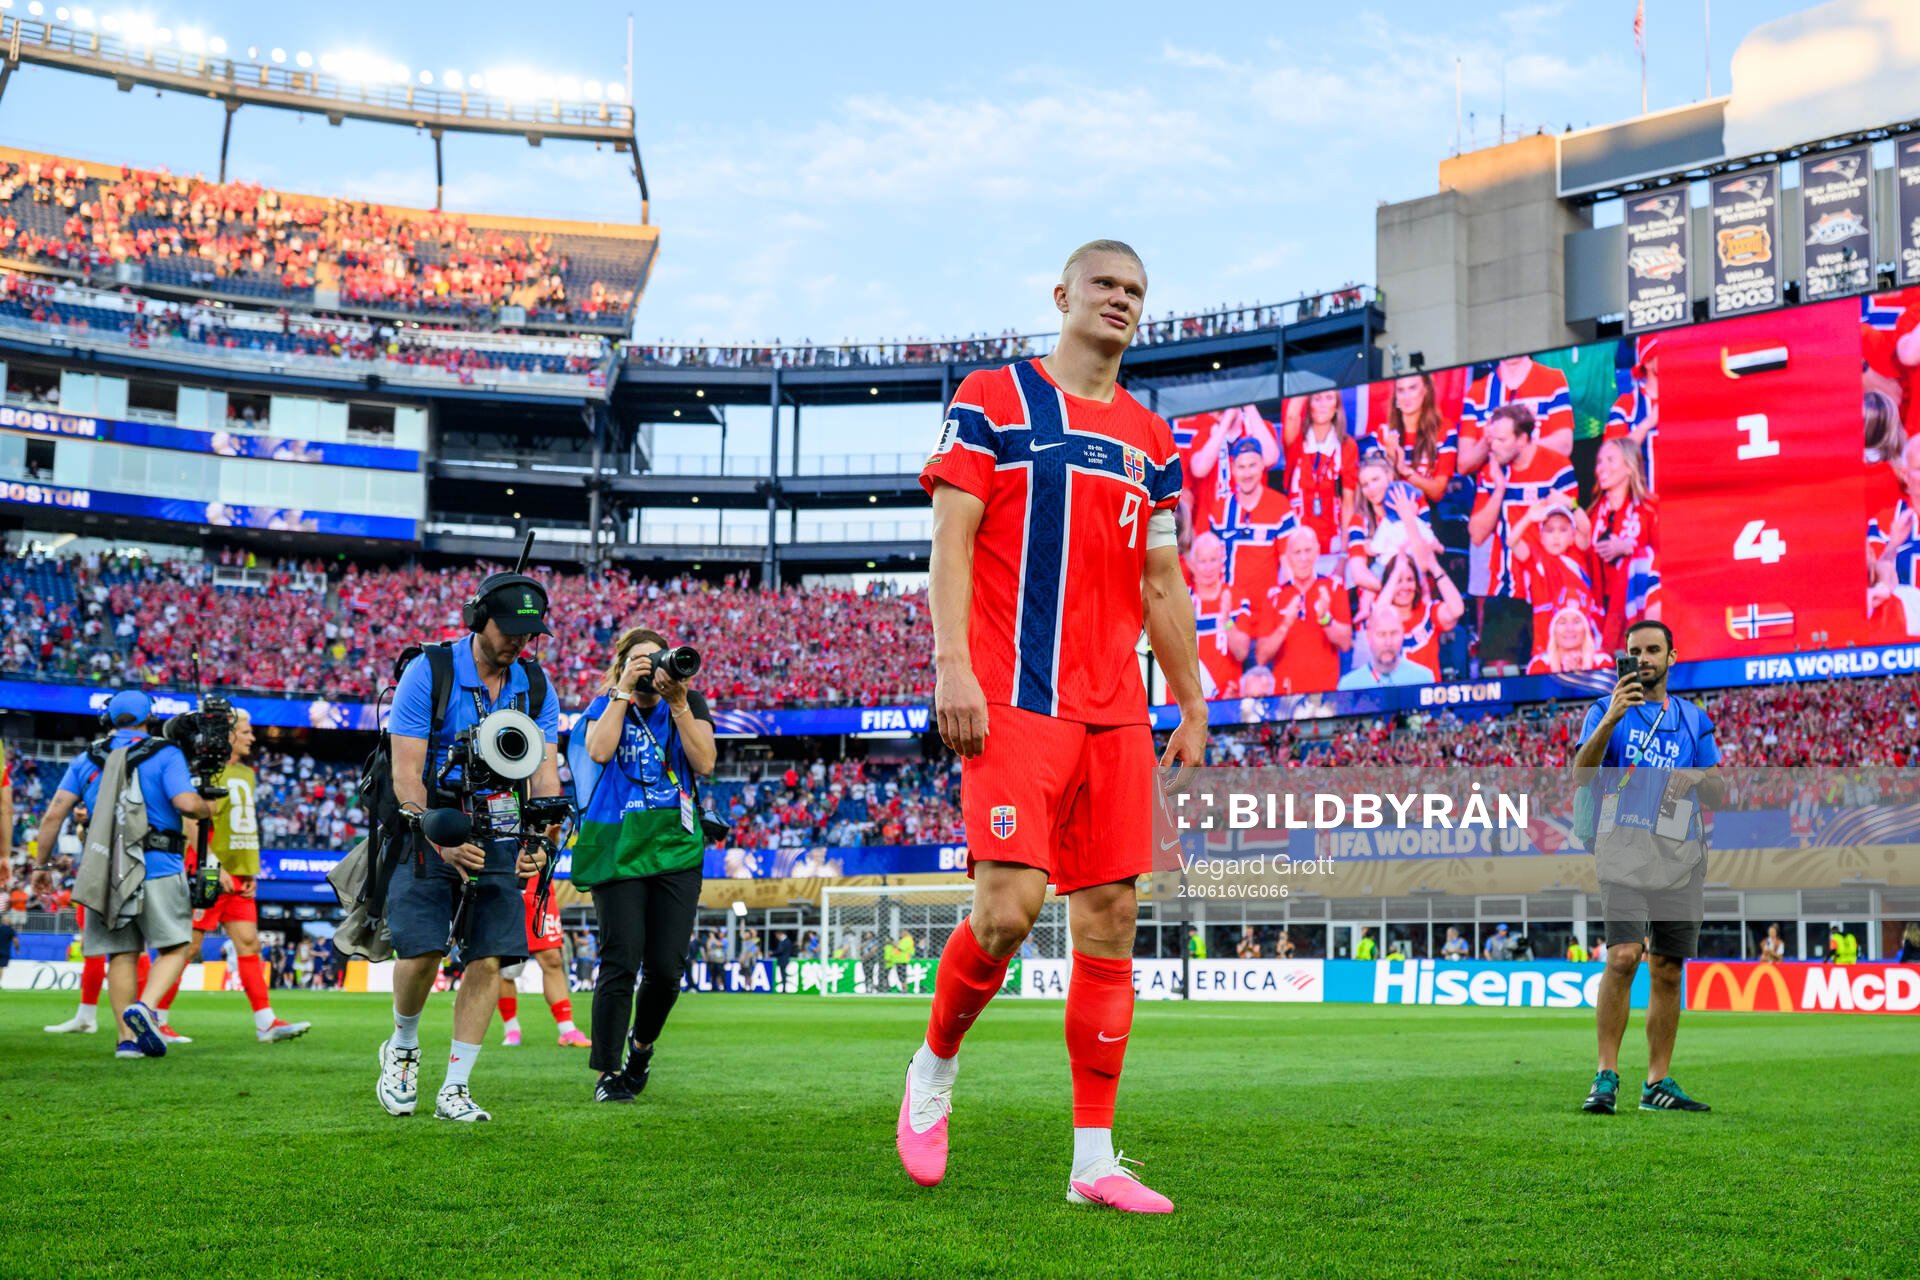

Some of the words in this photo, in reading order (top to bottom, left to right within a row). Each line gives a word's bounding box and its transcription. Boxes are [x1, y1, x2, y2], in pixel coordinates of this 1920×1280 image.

[1717, 286, 1774, 312] 2003
[1632, 303, 1684, 327] 2001
[0, 408, 96, 436] BOSTON
[1737, 413, 1780, 460] 1
[1118, 491, 1142, 549] 9
[1733, 520, 1786, 564] 4
[1745, 659, 1793, 682] FIFA
[1795, 652, 1879, 677] WORLD
[1420, 682, 1501, 706] BOSTON
[862, 709, 905, 729] FIFA
[1629, 728, 1660, 752] FIA
[1315, 831, 1373, 858] IFA
[1375, 827, 1477, 857] WORLD
